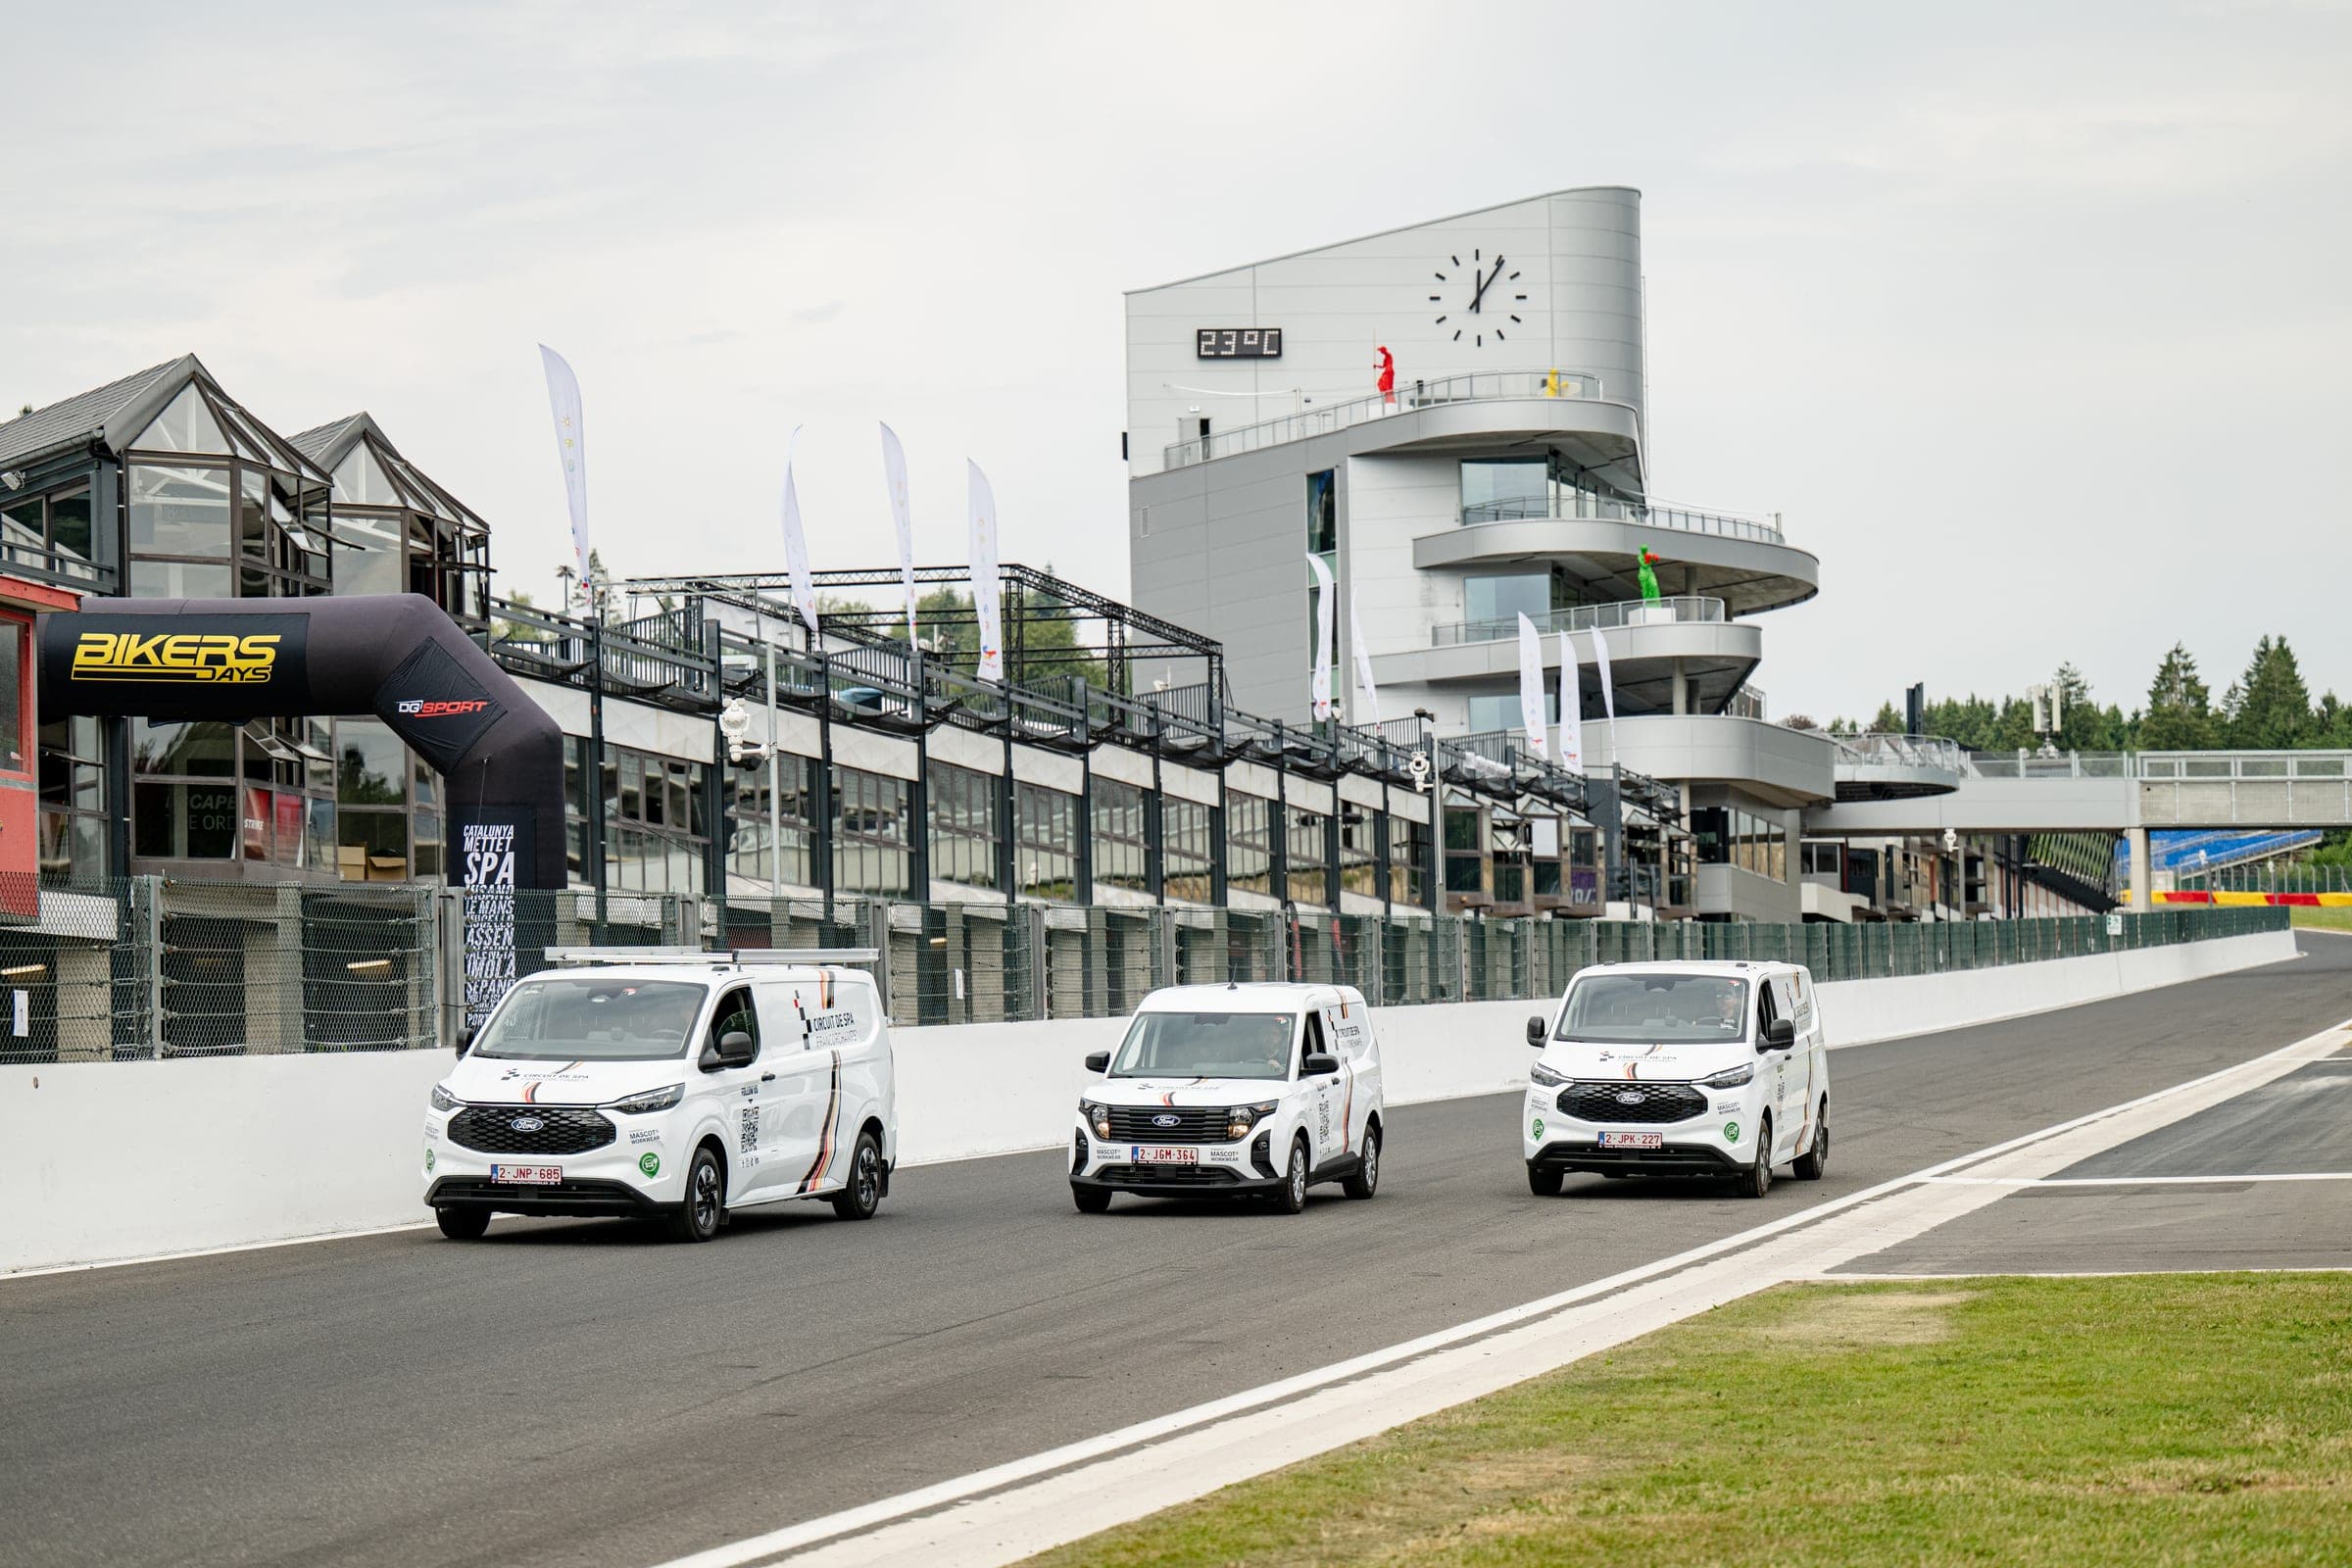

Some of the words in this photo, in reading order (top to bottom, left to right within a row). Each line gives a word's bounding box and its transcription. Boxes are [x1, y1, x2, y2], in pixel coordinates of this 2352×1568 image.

[74, 633, 281, 666] BIKERS
[197, 665, 272, 682] DAYS
[464, 825, 514, 839] CATALUNYA
[464, 837, 513, 852] METTET
[465, 852, 514, 885] SPA
[466, 901, 477, 914] LE
[479, 900, 515, 914] MANS
[466, 928, 515, 946] ASSEN
[466, 958, 516, 978] IMOLA
[813, 1015, 835, 1032] CIRCUIT
[835, 1013, 844, 1028] DE
[844, 1012, 856, 1026] SPA
